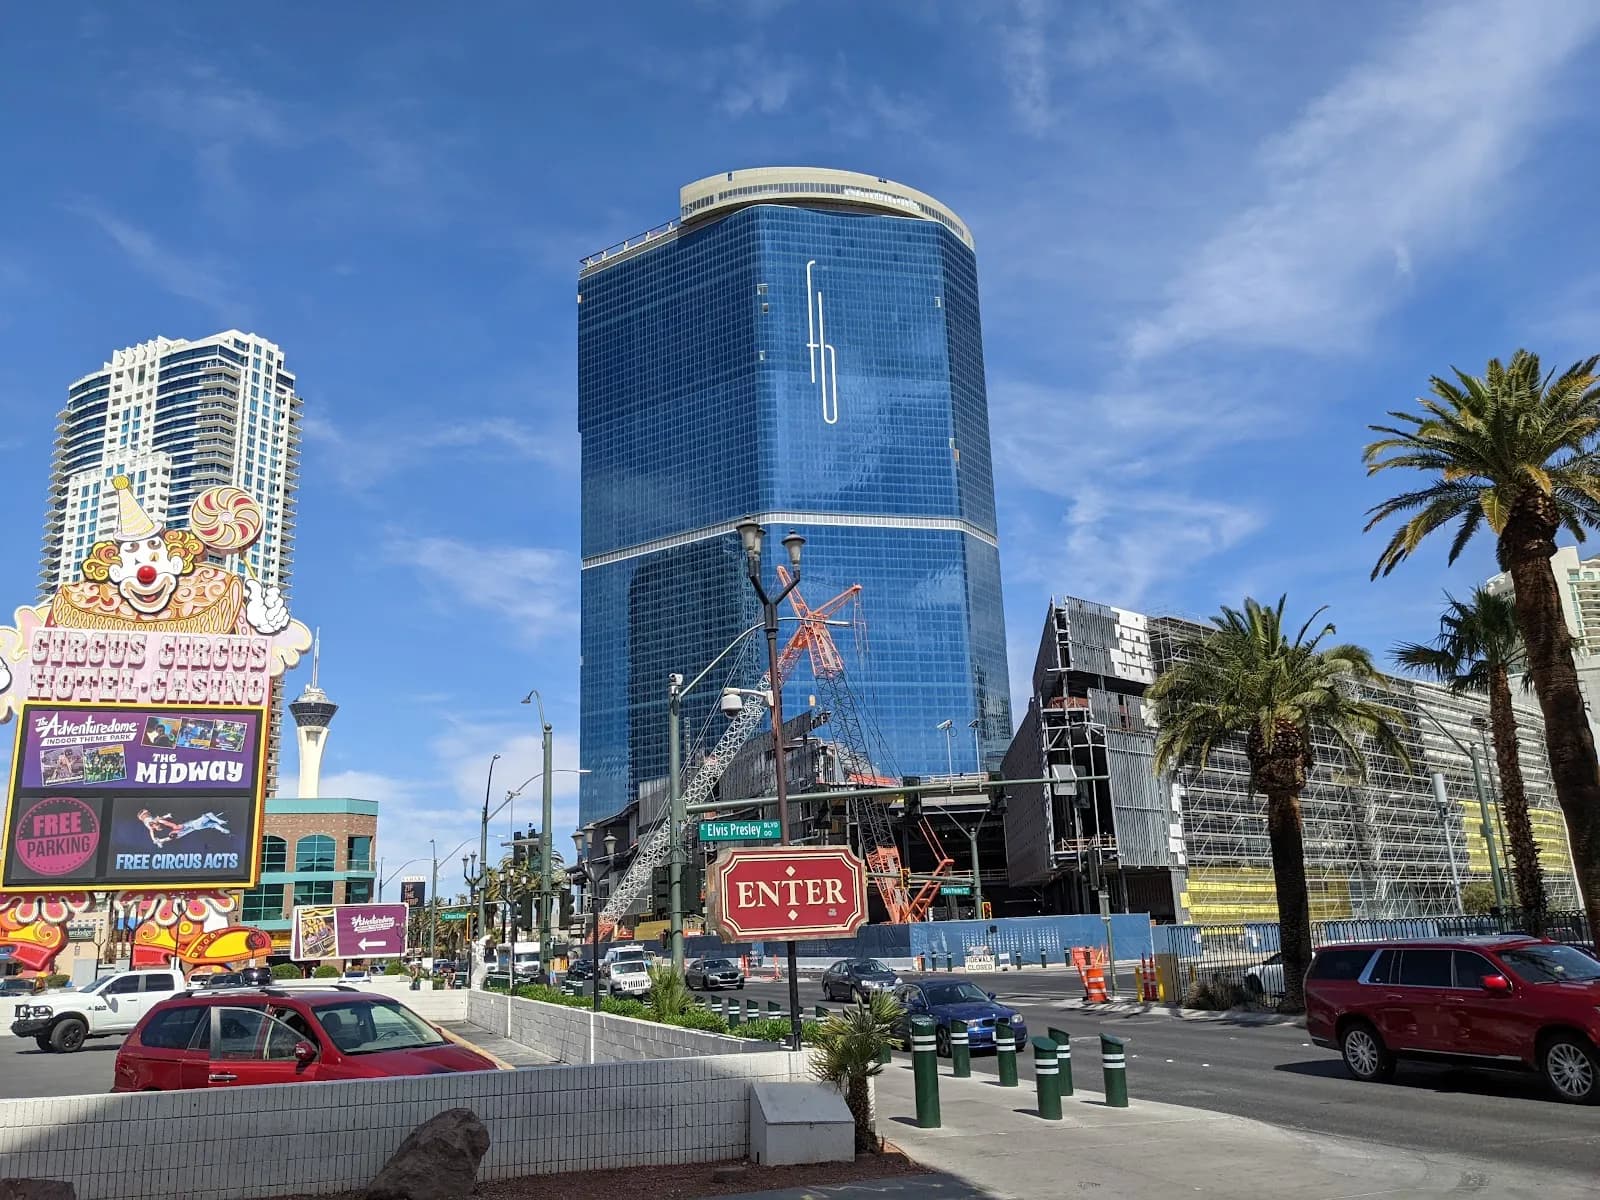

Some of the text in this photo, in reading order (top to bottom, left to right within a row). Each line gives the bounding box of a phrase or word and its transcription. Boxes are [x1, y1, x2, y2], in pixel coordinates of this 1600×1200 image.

[32, 631, 267, 672] CIRCUS CIRCUS
[35, 716, 48, 726] The
[35, 712, 137, 738] Adventuredome
[46, 737, 77, 745] INDOOR
[33, 811, 82, 837] FREE
[707, 823, 729, 837] Elvis
[730, 823, 761, 838] Presley
[27, 835, 91, 859] PARKING
[115, 852, 239, 870] FREE CIRCUS ACTS
[736, 878, 847, 908] ENTER
[967, 963, 993, 971] CLOSED
